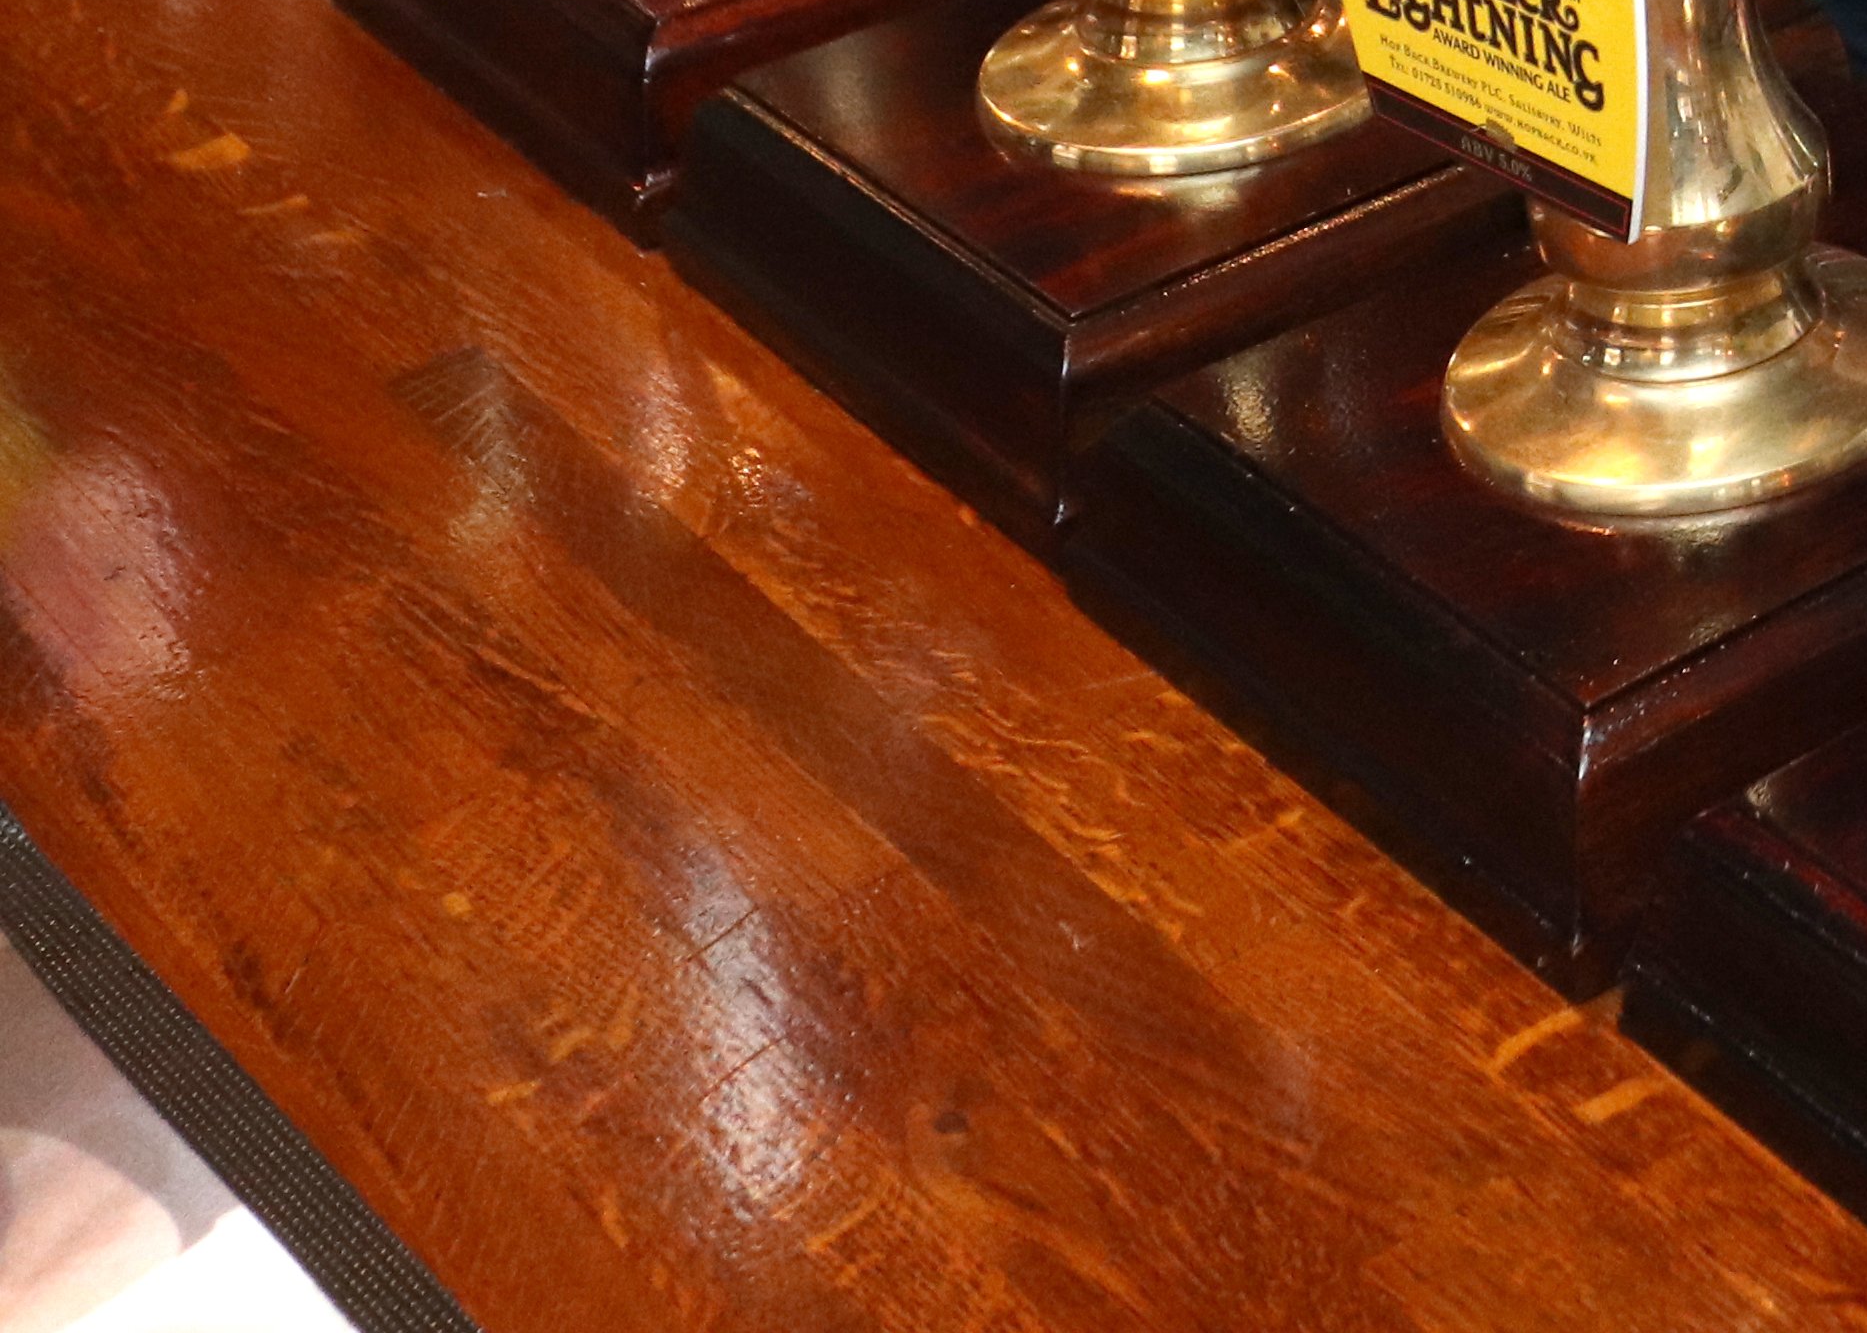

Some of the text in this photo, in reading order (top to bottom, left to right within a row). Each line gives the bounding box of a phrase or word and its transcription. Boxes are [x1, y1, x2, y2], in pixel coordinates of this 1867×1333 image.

[1411, 66, 1442, 91] 01725
[1432, 28, 1572, 104] AWARD WINNING ALE
[1460, 135, 1534, 183] ABV 5.0%
